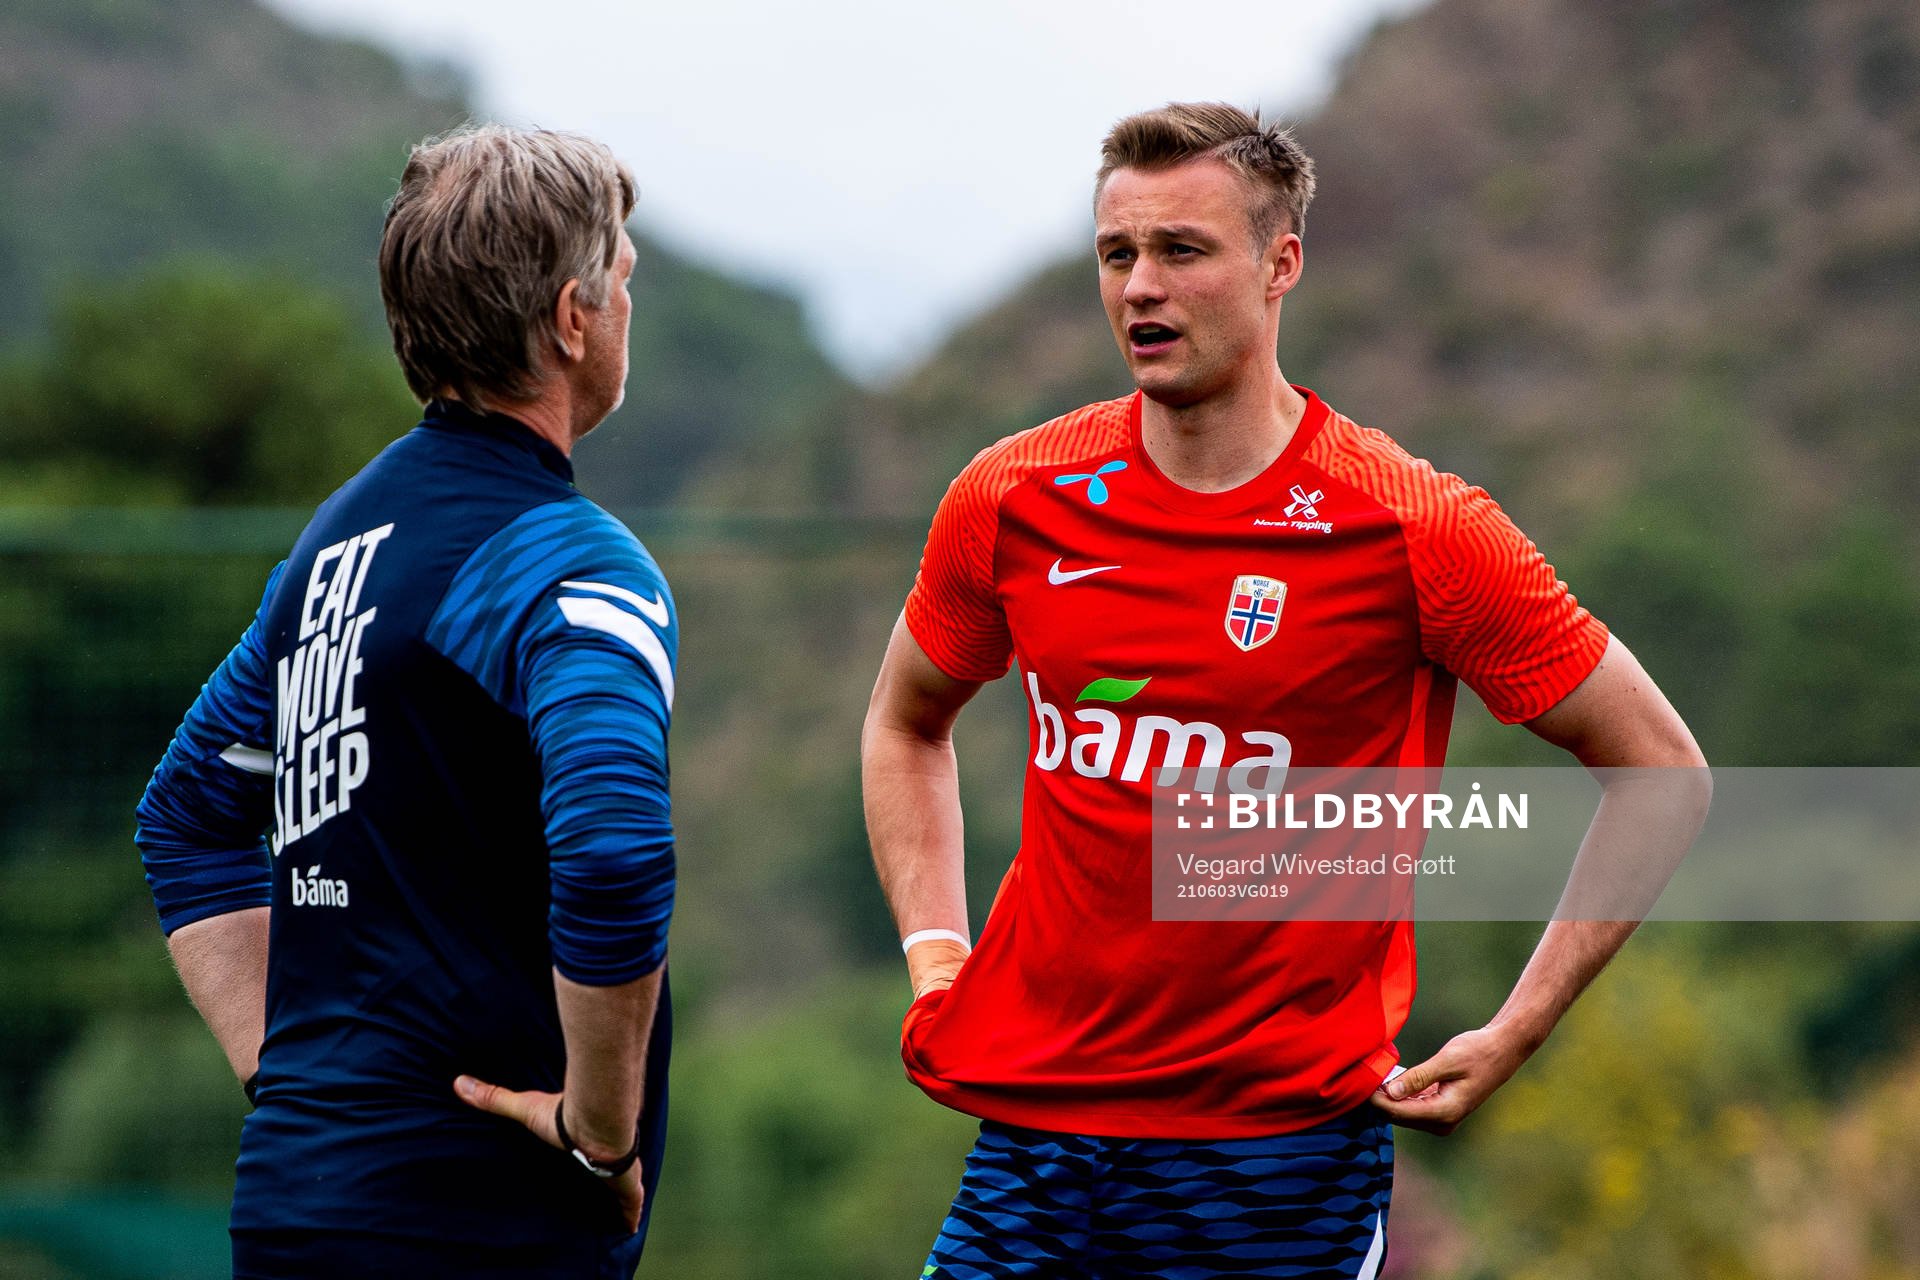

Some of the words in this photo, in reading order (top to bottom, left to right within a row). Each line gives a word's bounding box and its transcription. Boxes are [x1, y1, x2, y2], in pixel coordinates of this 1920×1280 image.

[298, 522, 395, 643] EAT
[1290, 520, 1333, 534] Tipping
[276, 606, 377, 764] MOVE
[271, 717, 370, 857] SLEEP
